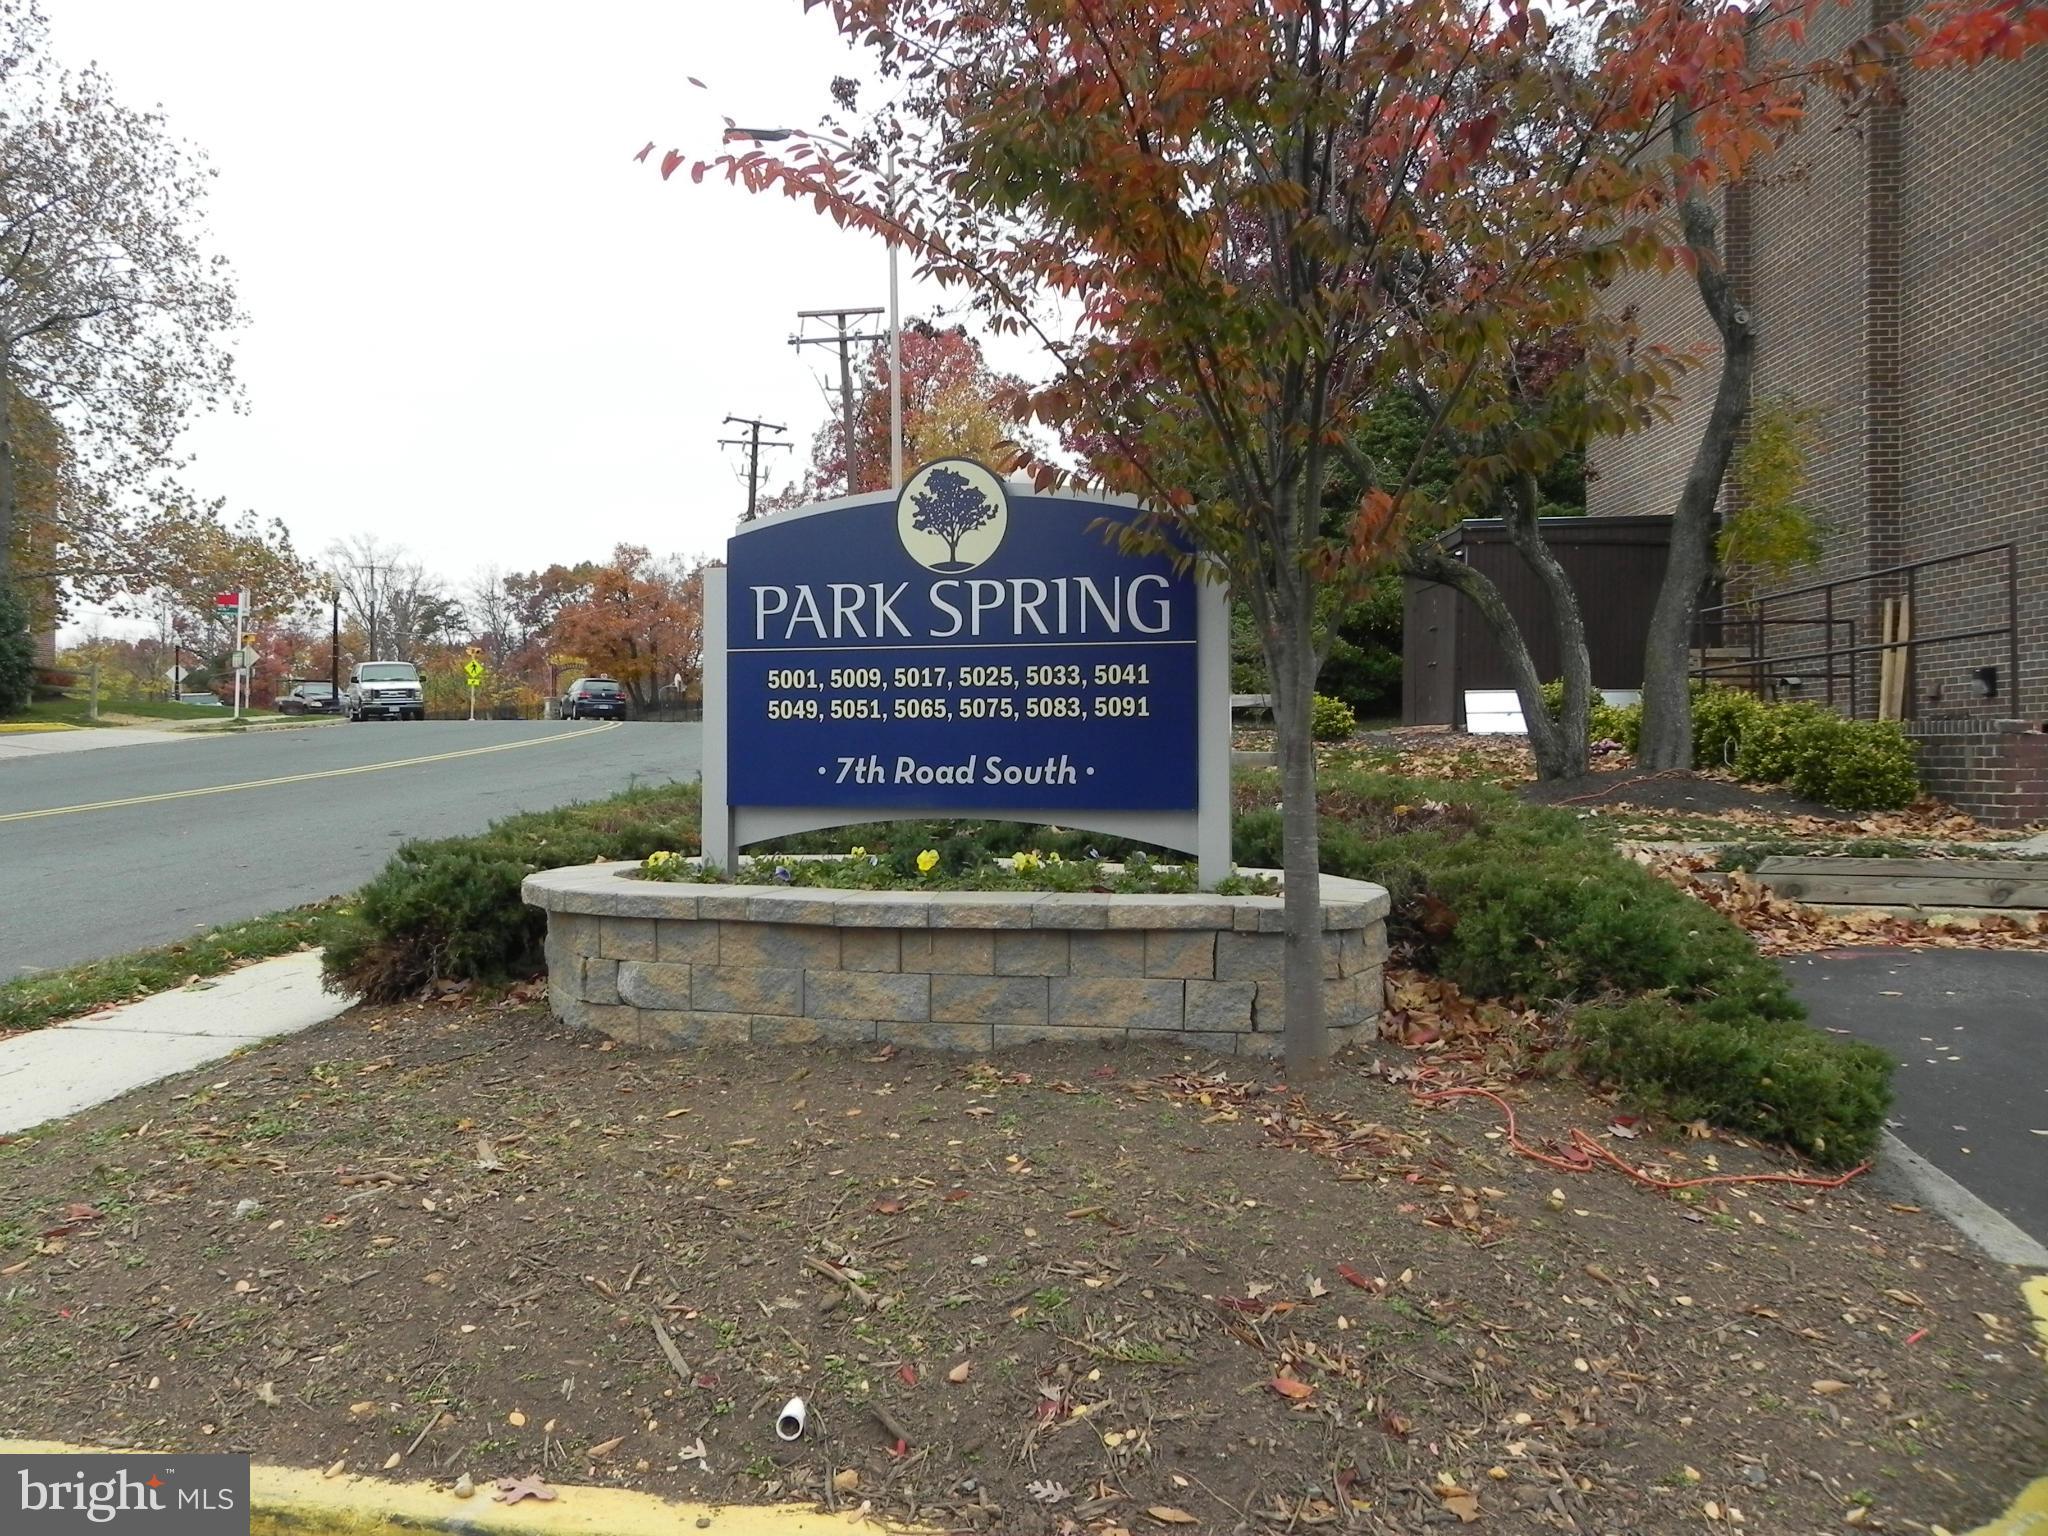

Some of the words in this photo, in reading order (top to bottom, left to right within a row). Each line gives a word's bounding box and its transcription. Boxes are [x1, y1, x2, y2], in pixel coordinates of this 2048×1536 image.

[750, 582, 912, 640] PARK
[929, 574, 1171, 638] SPRING
[767, 669, 824, 692] 5001,
[830, 668, 888, 692] 5009,
[893, 667, 953, 691] 5017,
[959, 666, 1019, 690] 5025,
[1025, 665, 1087, 689] 5033,
[1094, 664, 1150, 685] 5041
[767, 699, 824, 723] 5049,
[830, 699, 888, 723] 5051,
[893, 698, 953, 722] 5065,
[959, 697, 1019, 722] 5075,
[1025, 696, 1087, 721] 5083,
[1094, 696, 1150, 717] 5091
[835, 754, 886, 785] 7th
[894, 754, 977, 785] Road
[982, 754, 1077, 786] South
